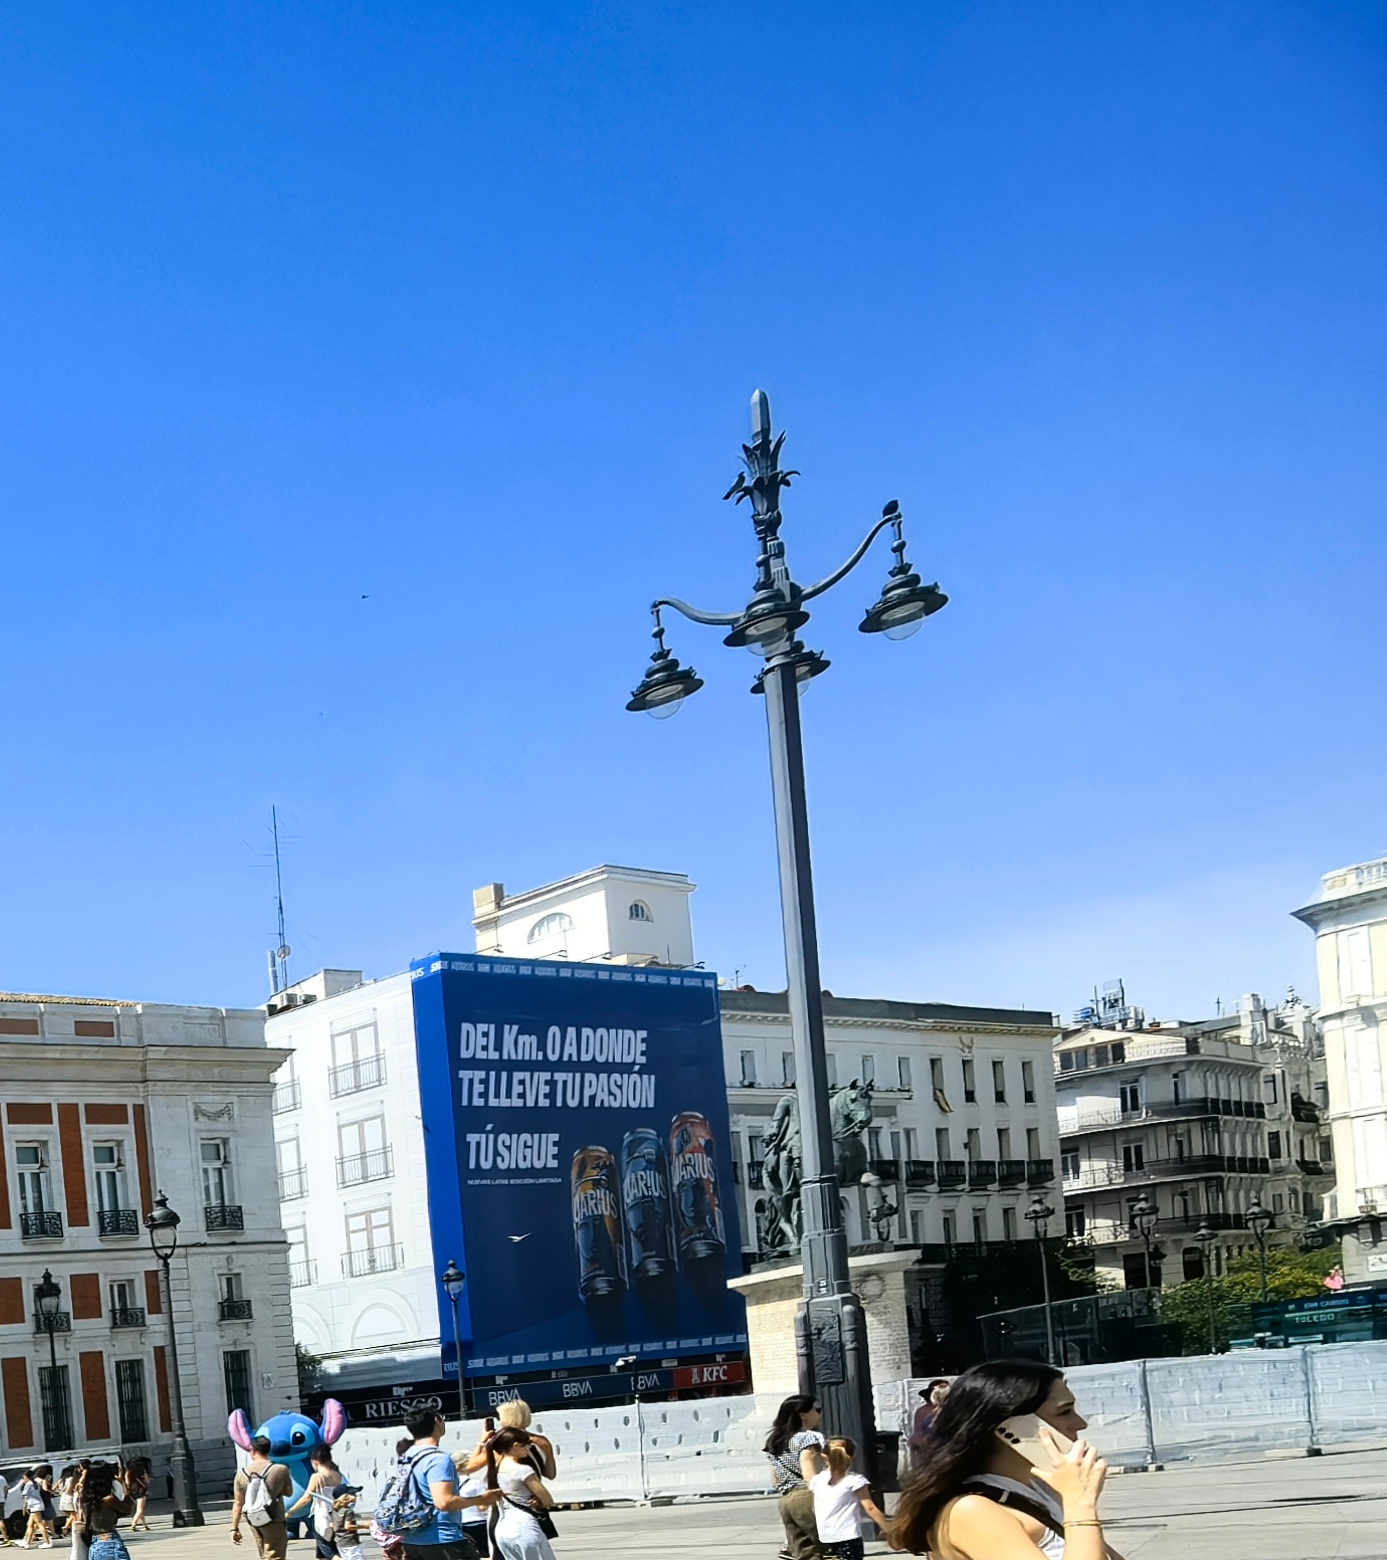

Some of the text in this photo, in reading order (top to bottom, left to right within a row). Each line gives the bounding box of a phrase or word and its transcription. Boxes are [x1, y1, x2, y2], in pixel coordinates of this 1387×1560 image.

[460, 1022, 500, 1060] DEL
[502, 1024, 543, 1061] Km.
[562, 1026, 578, 1062] A
[580, 1027, 647, 1064] DONDE
[458, 1065, 656, 1109] TE LLEVE TU PASIÓN
[466, 1124, 560, 1170] TÚ SIGUE
[1295, 1313, 1335, 1324] TOLEDO
[703, 1365, 728, 1382] KFC
[488, 1388, 522, 1406] BBVA
[562, 1380, 593, 1398] BBVA
[365, 1396, 443, 1419] RIESGO
